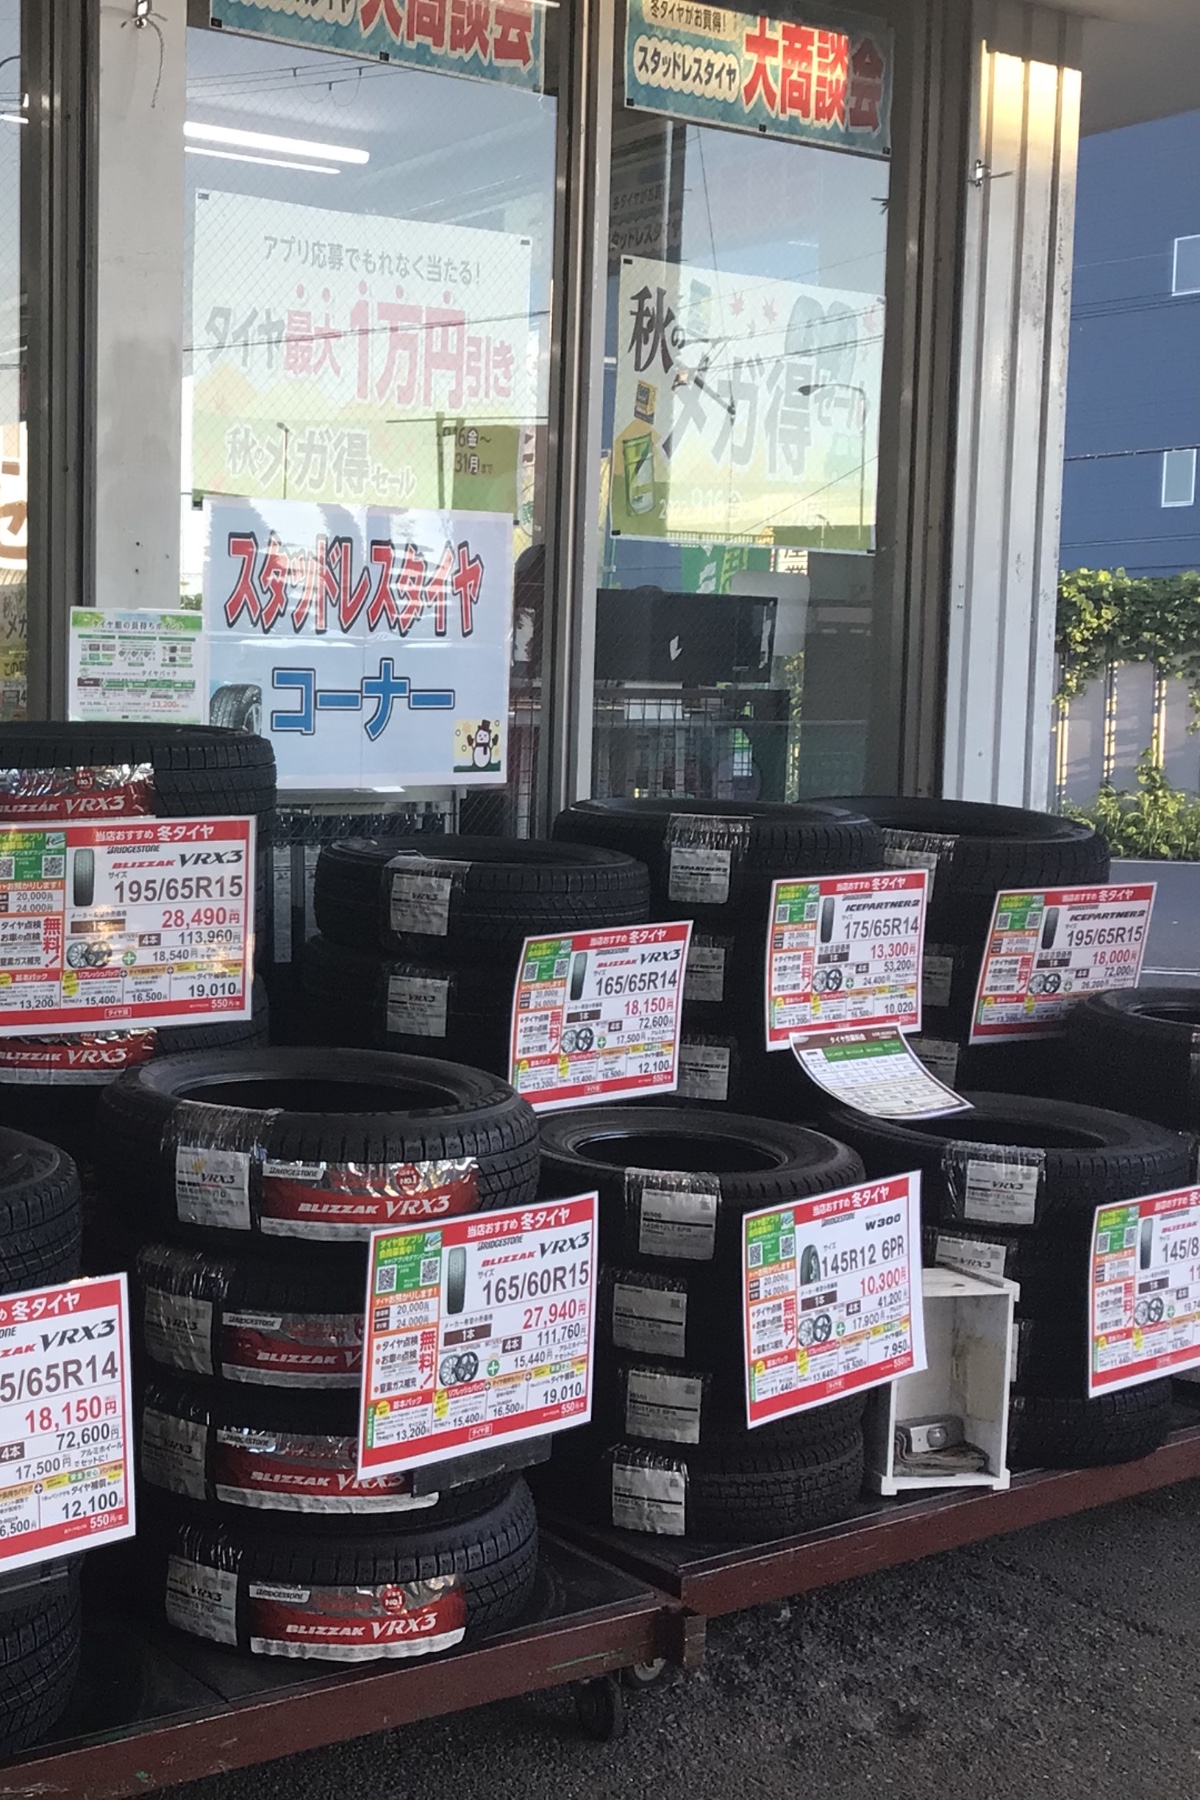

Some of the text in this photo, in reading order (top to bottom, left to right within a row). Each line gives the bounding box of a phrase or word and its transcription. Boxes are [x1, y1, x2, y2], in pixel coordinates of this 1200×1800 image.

[638, 46, 736, 90] スタッドレスタイヤ
[742, 15, 884, 134] 大商談会
[224, 529, 484, 639] スタッドレスタイヤ
[271, 656, 455, 740] コーナー
[64, 796, 125, 814] VRX3
[95, 825, 214, 841] 当店おすすめ 冬タイヤ
[112, 850, 243, 869] BLIZZAK VRX3
[114, 874, 243, 903] 195/65R15
[872, 877, 906, 890] 冬タイヤ
[1099, 890, 1133, 901] 冬タイヤ
[629, 929, 666, 944] 冬タイヤ
[844, 917, 919, 939] 175/65R14
[1067, 926, 1143, 947] 195/65R15
[640, 949, 680, 965] VRX3
[596, 969, 677, 996] 165/65R14
[67, 1050, 128, 1063] VRX3
[201, 1173, 236, 1184] VRX3
[298, 1195, 451, 1217] BLIZZAK VRX3
[852, 1187, 889, 1207] 冬タイヤ
[467, 1208, 570, 1238] 当店おすすめ 冬タイヤ
[865, 1214, 901, 1231] W300
[481, 1233, 589, 1267] BLIZZAK VRX3
[822, 1235, 904, 1277] 145R12 6PR
[483, 1261, 589, 1306] 165/60R15
[11, 1292, 80, 1321] 冬タイヤ
[40, 1318, 116, 1352] VRX3
[286, 1613, 437, 1638] BLIZZAK VRX3
